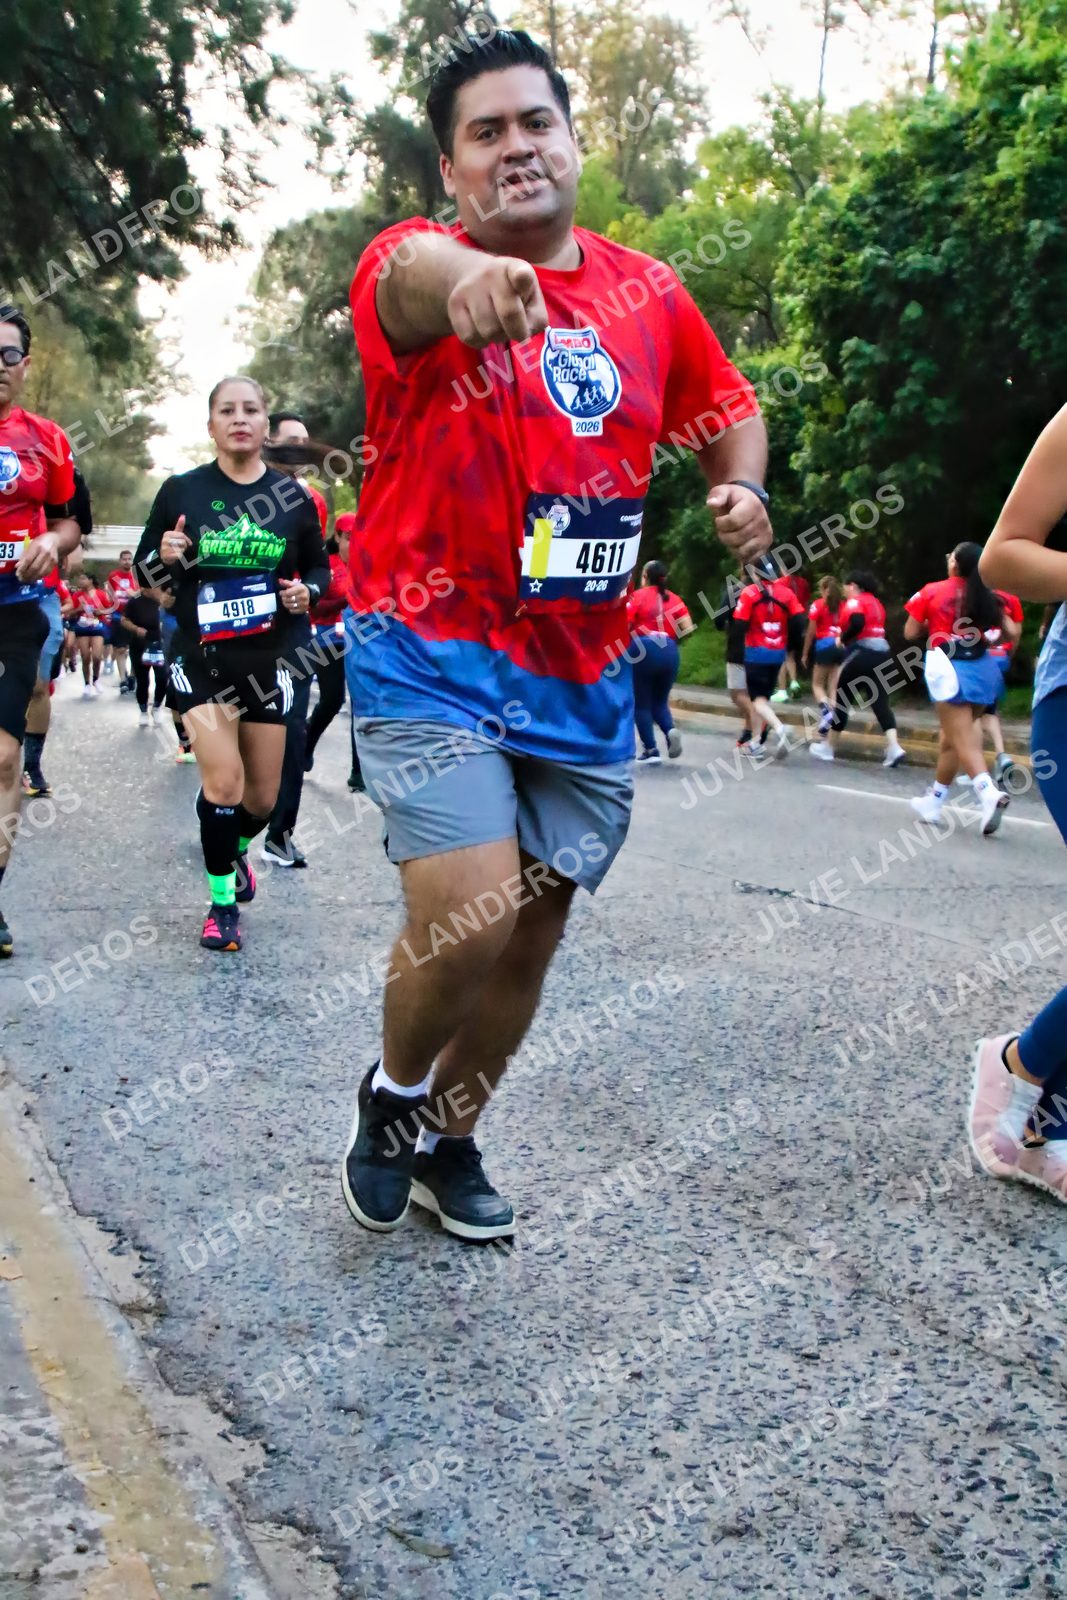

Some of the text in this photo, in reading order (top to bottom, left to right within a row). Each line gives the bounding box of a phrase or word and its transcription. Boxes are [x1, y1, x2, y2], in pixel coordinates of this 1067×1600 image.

[553, 366, 587, 382] Race
[575, 421, 600, 433] 2026
[0, 543, 15, 558] 33
[202, 540, 283, 557] GREEN TEAM
[576, 541, 626, 574] 4611
[222, 599, 255, 618] 4918
